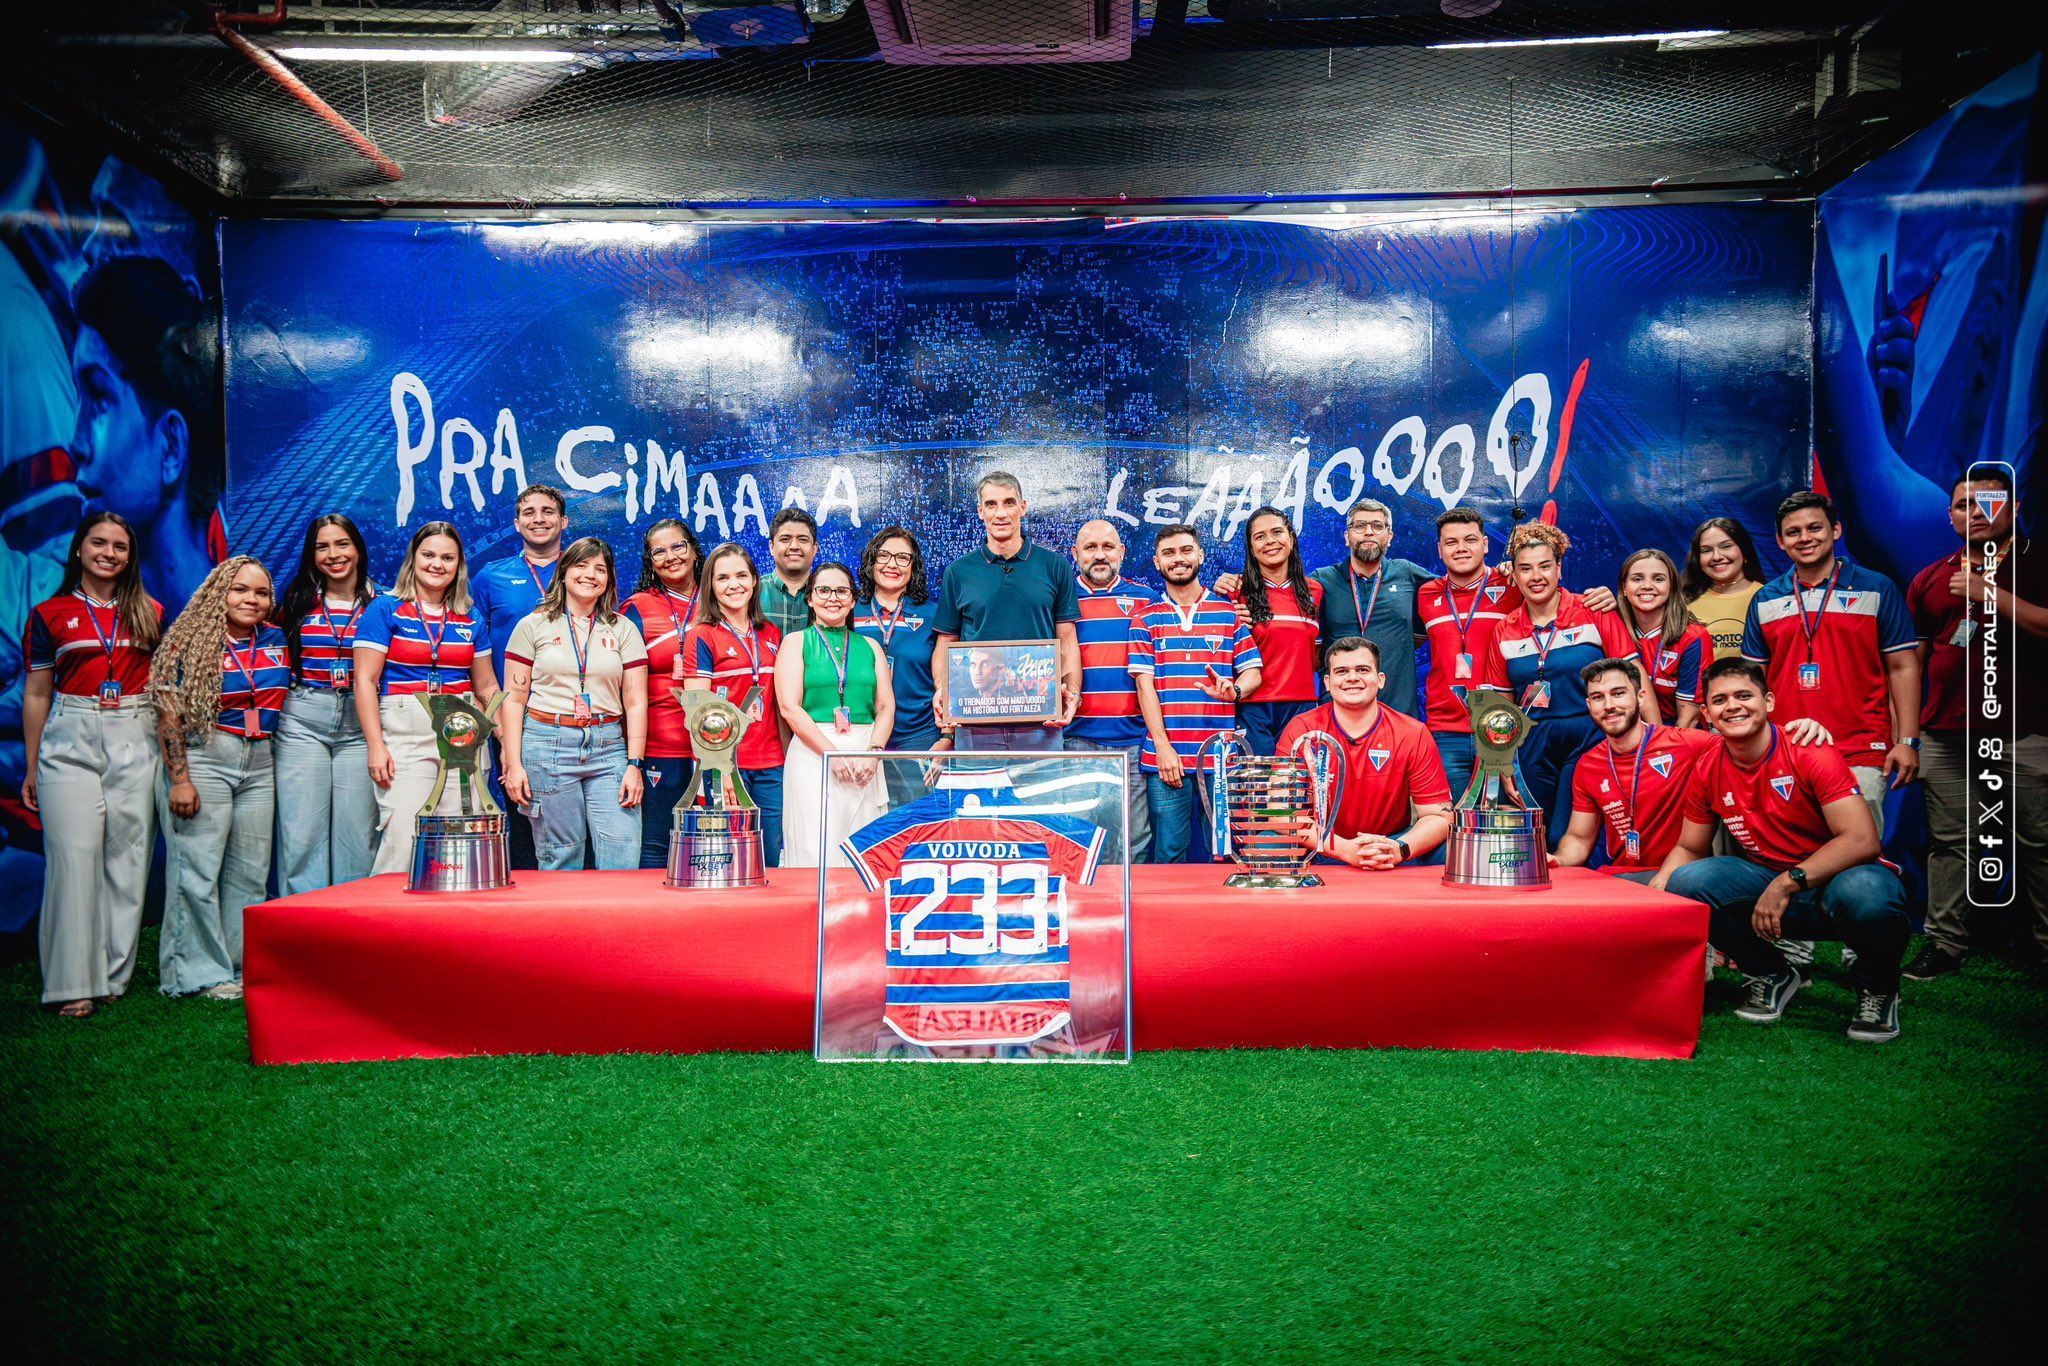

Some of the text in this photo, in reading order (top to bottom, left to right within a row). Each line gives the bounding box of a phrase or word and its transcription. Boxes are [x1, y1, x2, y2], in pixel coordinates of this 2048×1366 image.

[391, 372, 529, 527] PRA
[958, 695, 1046, 706] O TREINADOR COM MAIS JOGOS
[963, 704, 1042, 714] NA HISTÓRIA DO FORTALEZA
[928, 843, 1021, 858] VOJVODA
[900, 862, 1049, 956] 233
